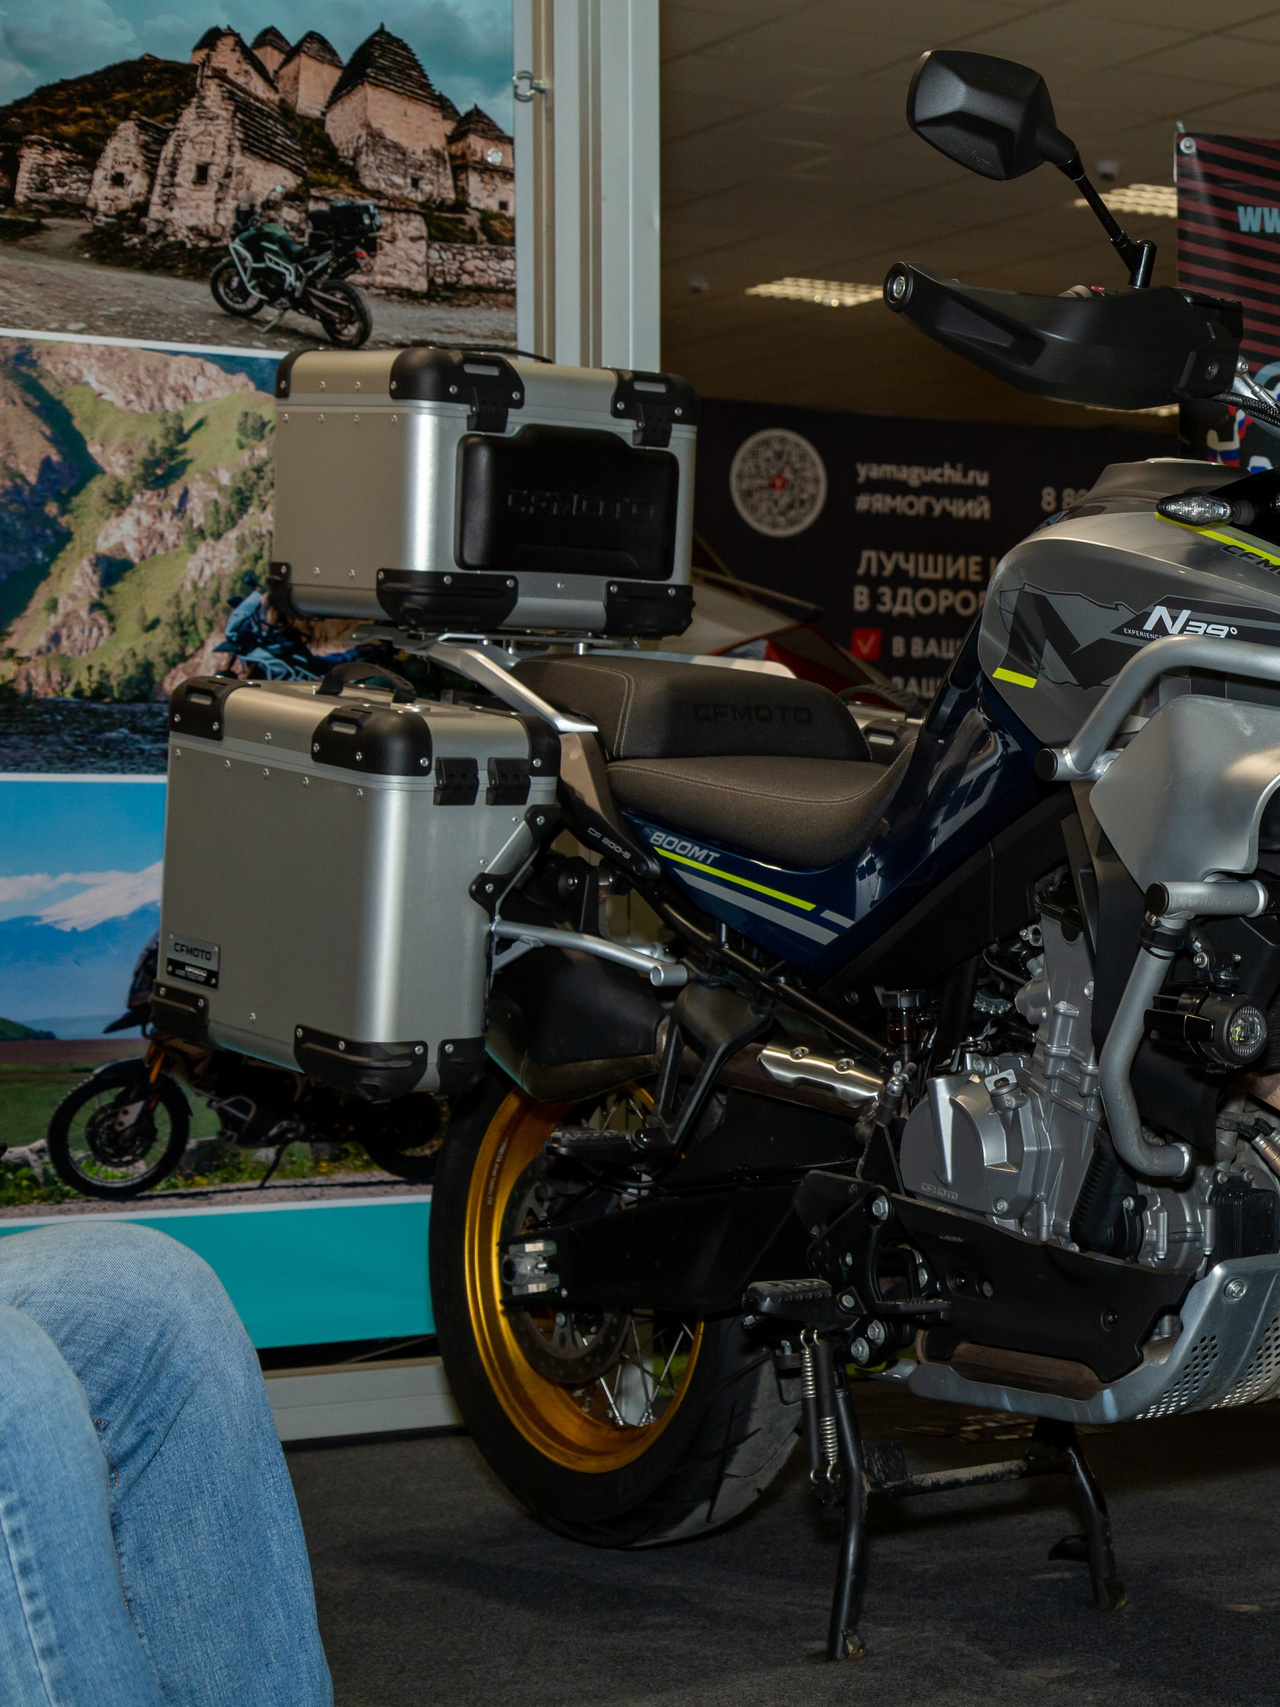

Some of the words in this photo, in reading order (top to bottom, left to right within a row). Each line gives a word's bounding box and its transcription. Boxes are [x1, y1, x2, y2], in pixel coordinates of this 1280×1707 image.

[856, 462, 989, 487] yamaguchi.ru
[508, 488, 654, 520] CFMOTO
[855, 492, 991, 521] #ЯМОГУЧИЙ
[1041, 486, 1057, 512] 8
[857, 550, 982, 581] ЛУЧШИЕ
[853, 585, 870, 612] В
[892, 635, 906, 659] В
[693, 703, 813, 724] CFMOTO
[587, 827, 602, 839] CF
[649, 831, 720, 865] 800MT
[174, 942, 212, 961] CFMOTO
